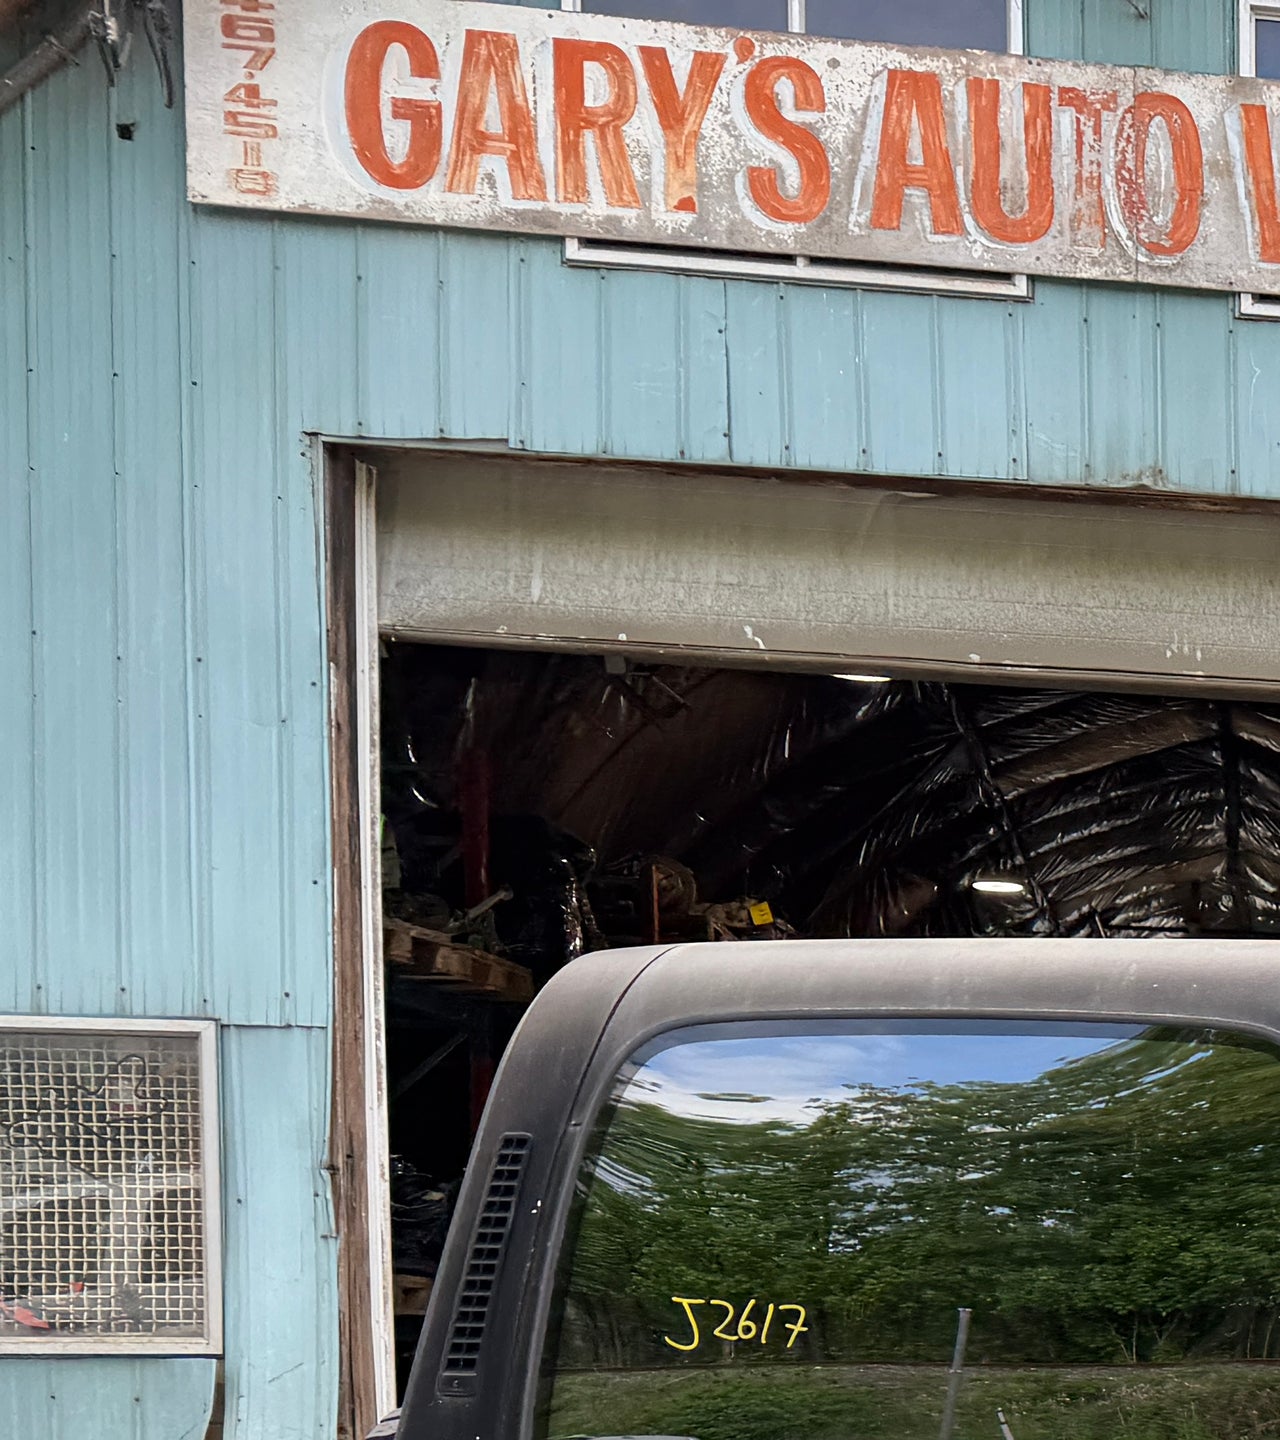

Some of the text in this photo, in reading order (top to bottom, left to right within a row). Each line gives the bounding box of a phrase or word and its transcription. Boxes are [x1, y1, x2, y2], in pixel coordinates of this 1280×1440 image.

[345, 20, 831, 224] GARY'S
[870, 69, 1204, 256] AUTO
[664, 1296, 809, 1351] J2617
